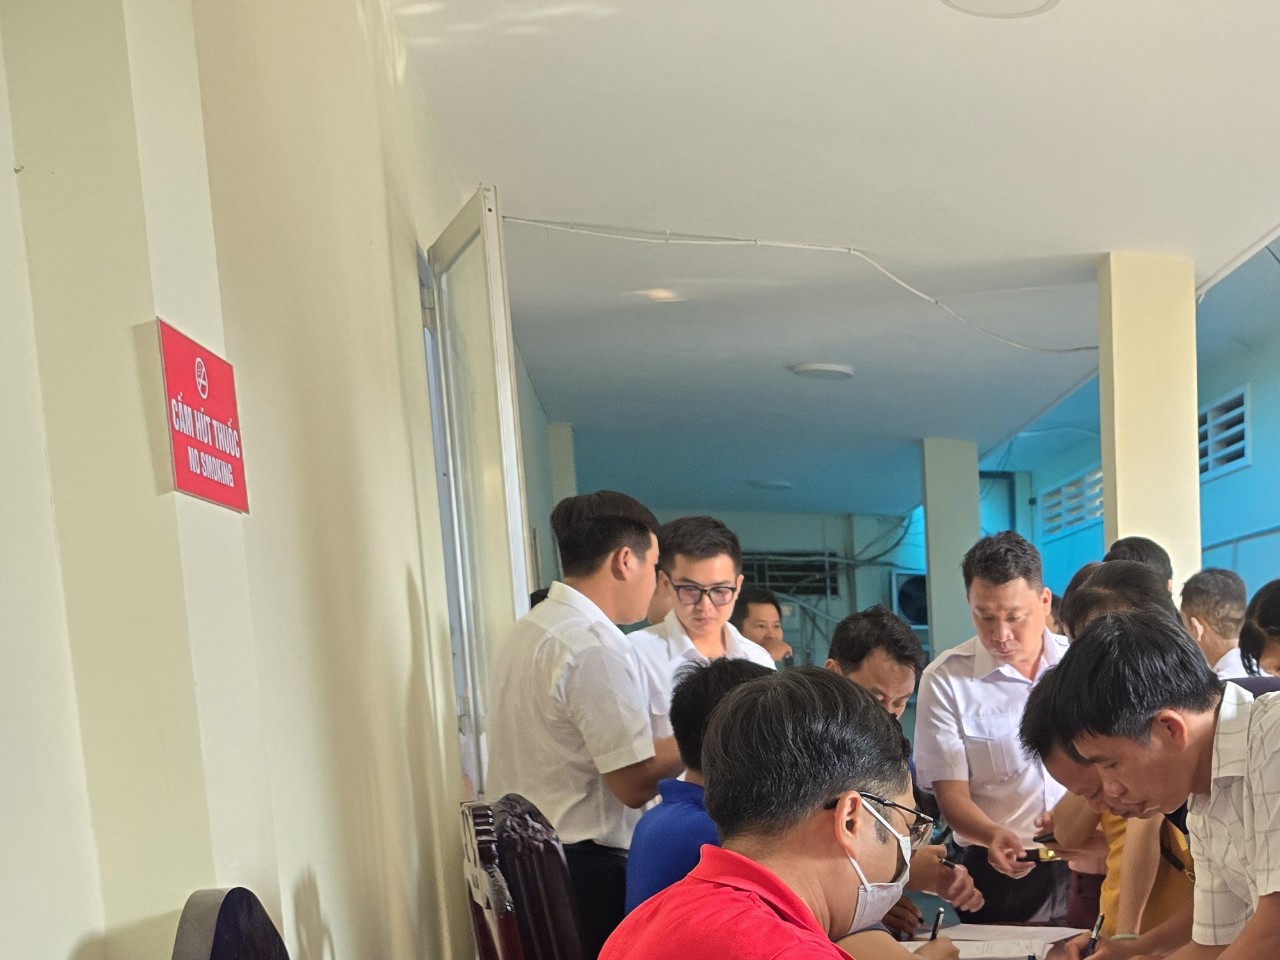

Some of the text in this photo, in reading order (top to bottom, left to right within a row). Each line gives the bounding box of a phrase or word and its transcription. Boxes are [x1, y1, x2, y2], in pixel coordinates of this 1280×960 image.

[171, 392, 240, 459] CẤM HÚT THUỐC
[188, 446, 235, 488] NO SMOKING
